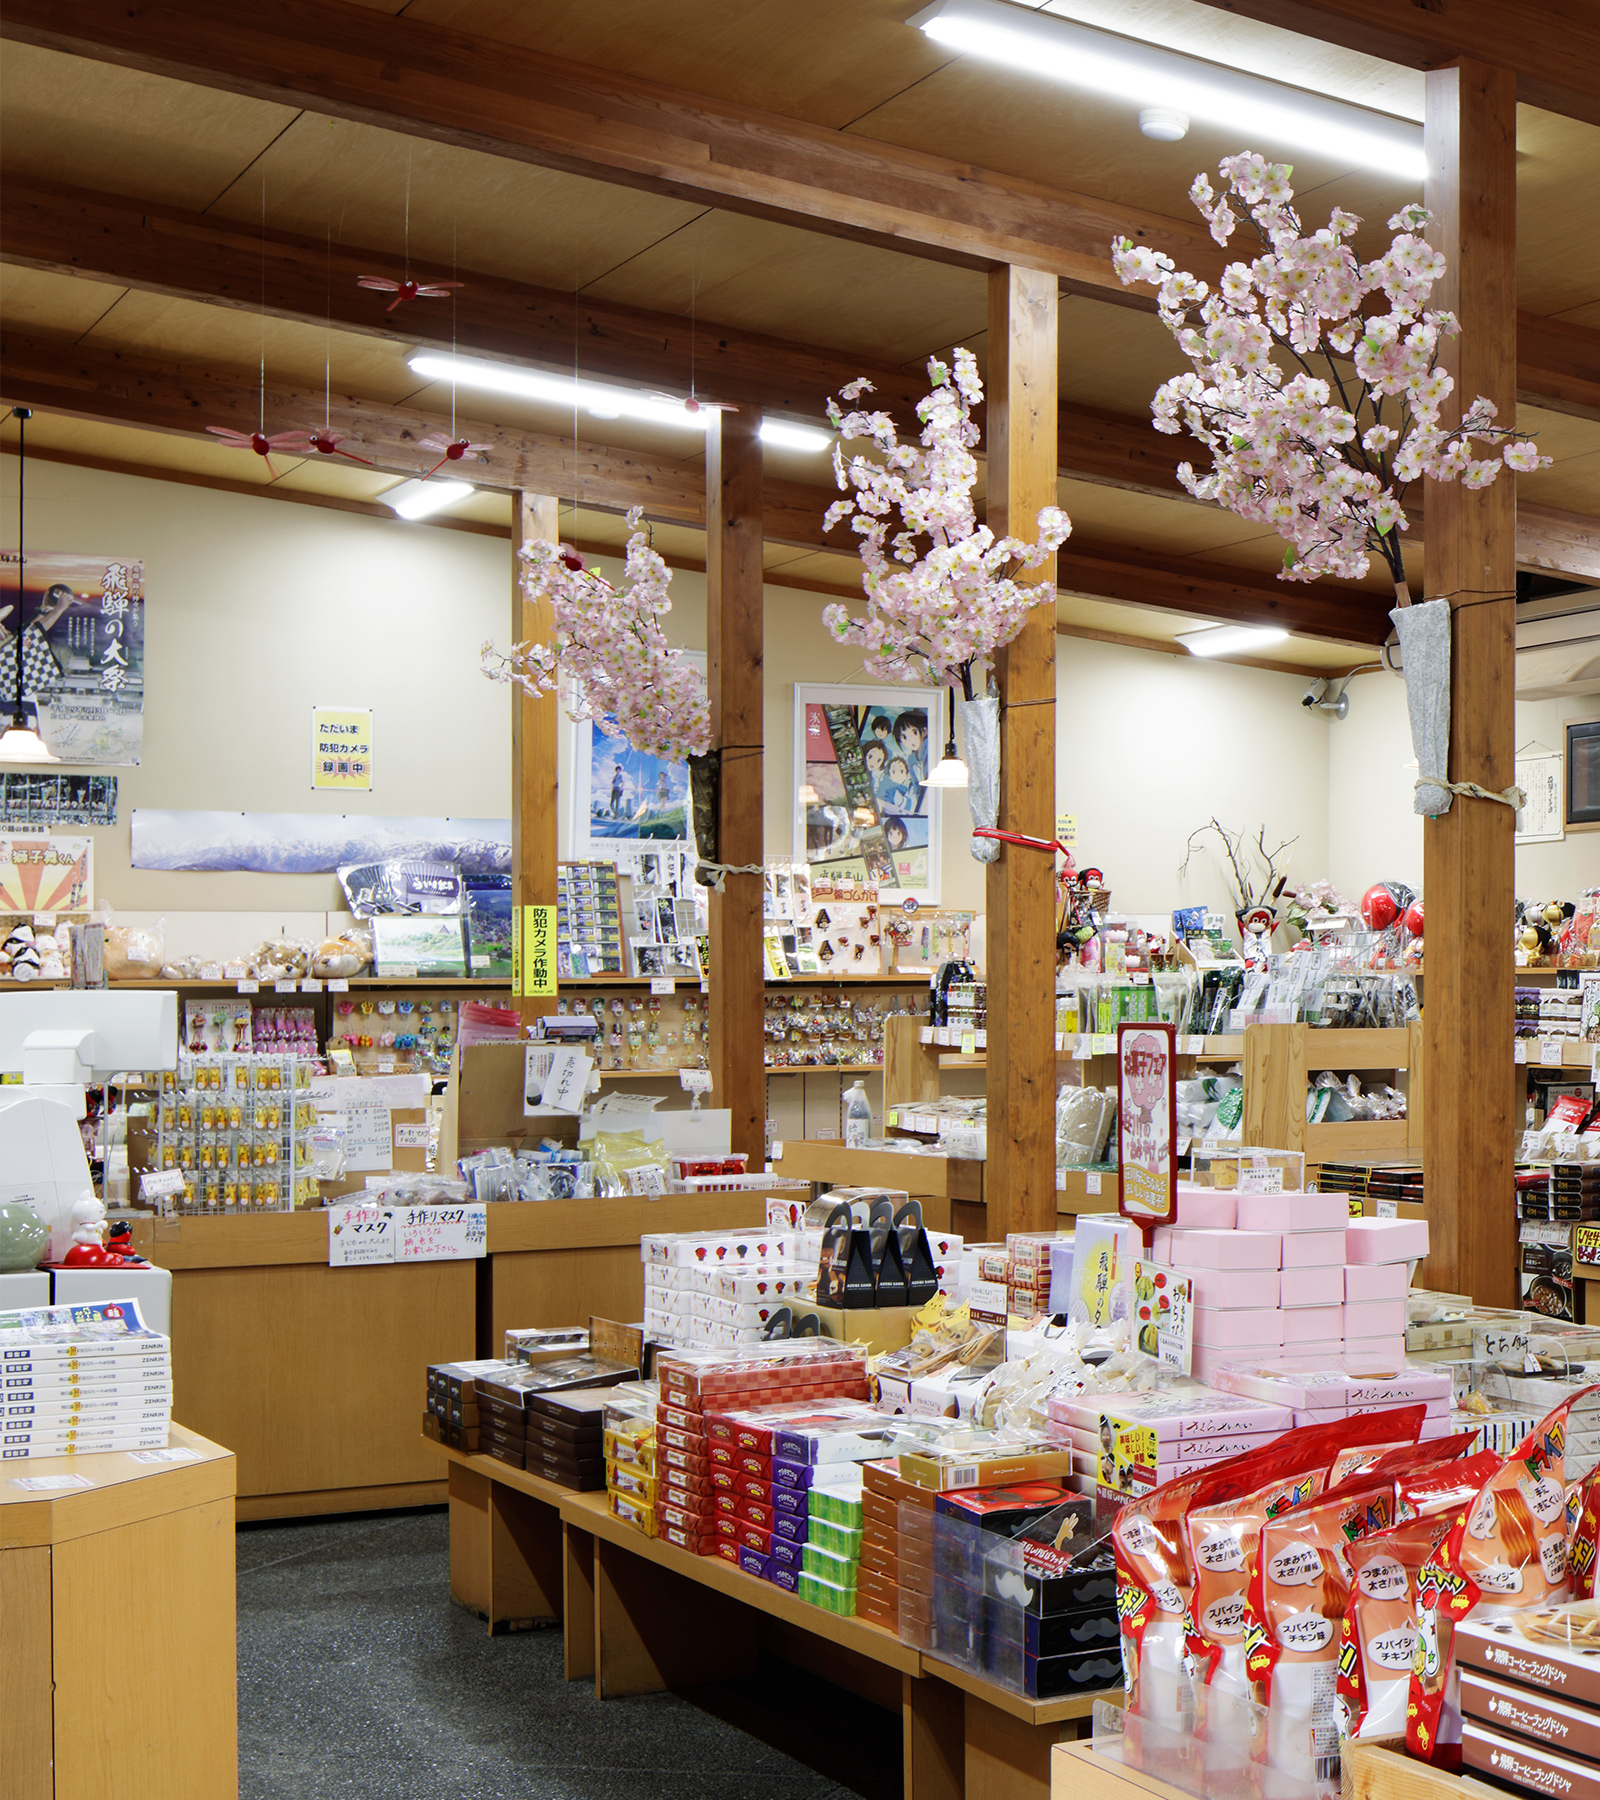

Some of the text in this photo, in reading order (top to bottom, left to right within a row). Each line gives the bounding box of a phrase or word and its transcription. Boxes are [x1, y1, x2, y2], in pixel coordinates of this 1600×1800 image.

[319, 723, 359, 734] ただいま
[319, 743, 368, 754] 防犯カメラ
[322, 761, 364, 773] 録画中
[533, 908, 548, 988] 防犯カメラ作動中
[1124, 1051, 1167, 1077] お菓子フェア
[343, 1210, 379, 1224] 手作り
[406, 1210, 465, 1225] 手作りマスク
[351, 1222, 388, 1234] マスク
[1282, 1620, 1326, 1633] スパイシー
[1288, 1631, 1326, 1643] チキン味
[1493, 1648, 1568, 1684] 飛騨コーヒーラングドシャ
[1497, 1699, 1569, 1738] 飛騨コーヒーラングドシャ
[1499, 1753, 1572, 1792] 飛騨コーヒーラングドシャ
